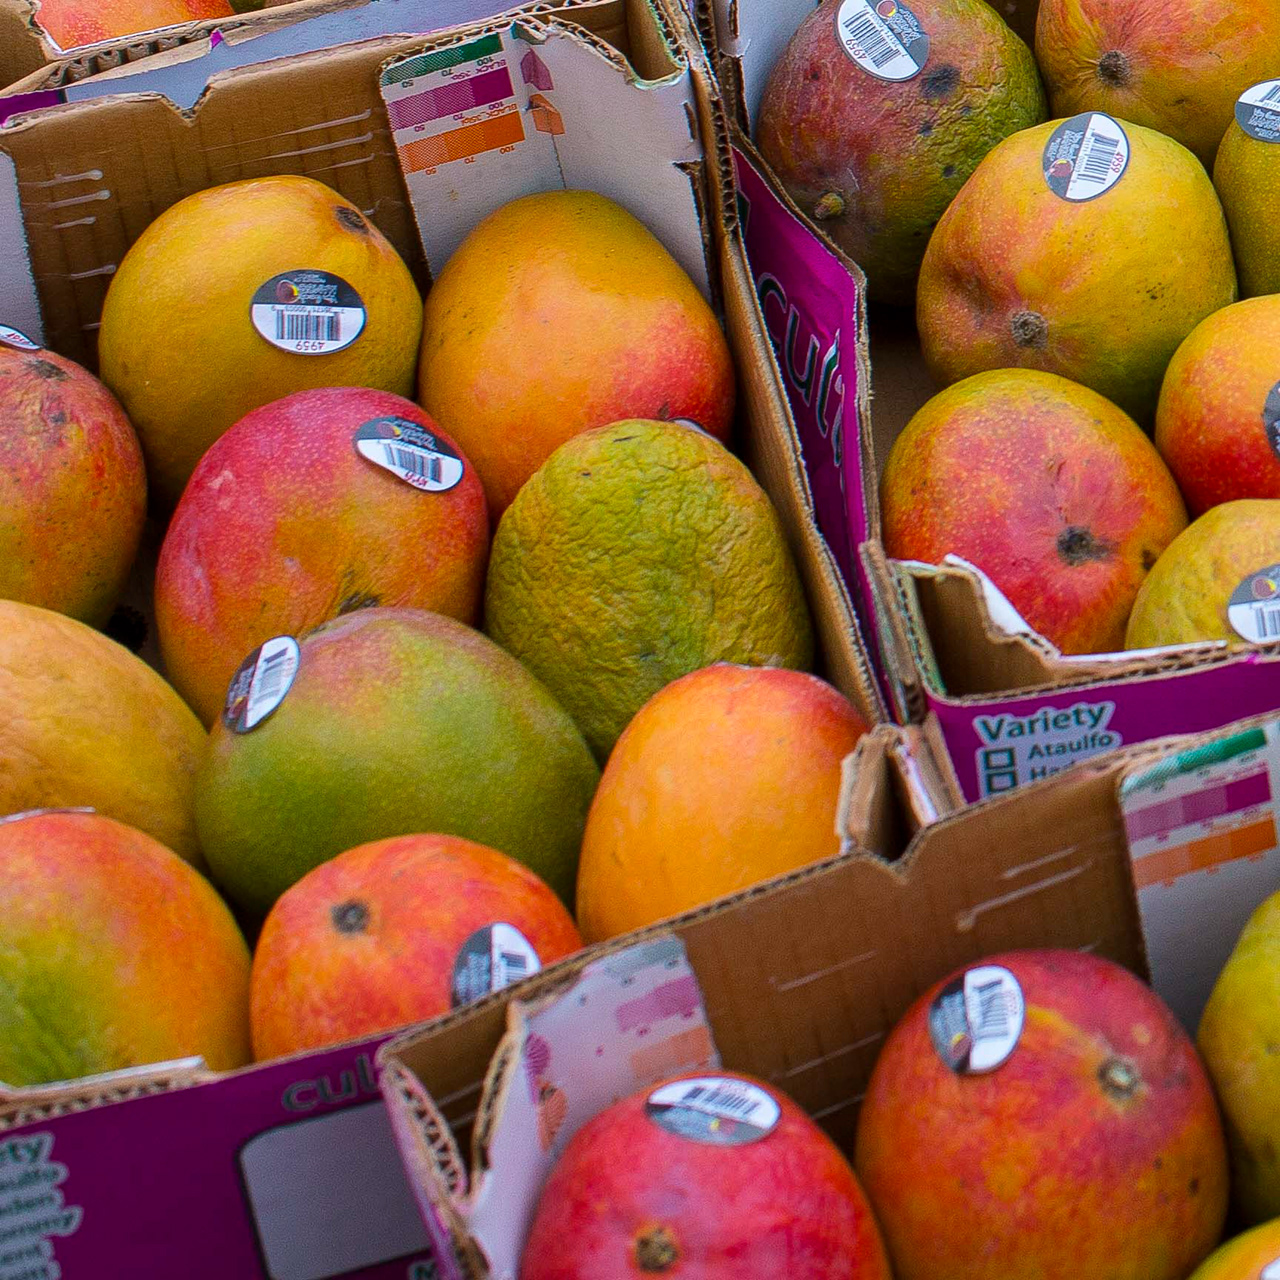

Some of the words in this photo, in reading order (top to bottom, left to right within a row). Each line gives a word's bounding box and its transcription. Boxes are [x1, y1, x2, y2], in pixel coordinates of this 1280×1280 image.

[846, 37, 867, 60] 4959
[1110, 152, 1123, 173] 4959
[296, 341, 326, 352] 4959
[981, 704, 1107, 742] Variety
[1027, 732, 1114, 761] Ataulfo
